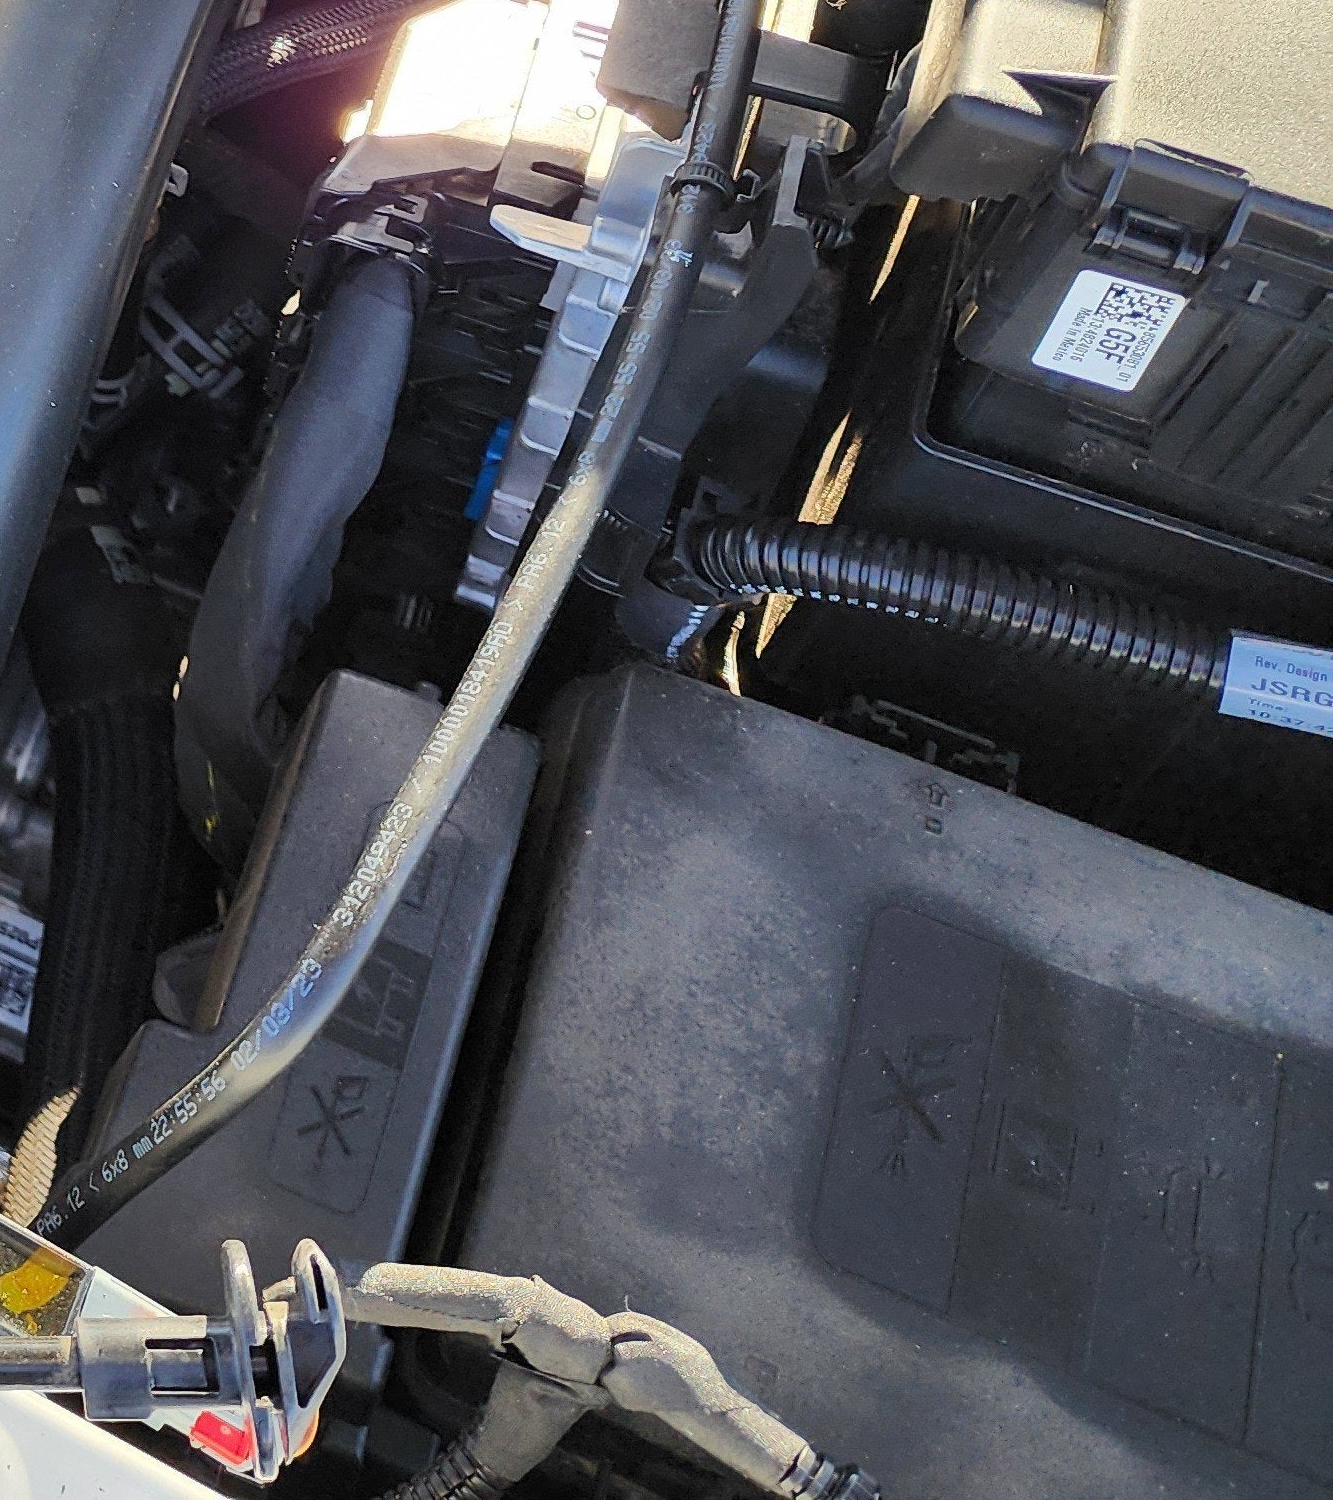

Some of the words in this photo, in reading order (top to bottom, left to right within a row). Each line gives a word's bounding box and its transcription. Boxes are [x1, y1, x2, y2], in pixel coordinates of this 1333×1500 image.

[1052, 337, 1076, 361] Mexico
[1095, 327, 1137, 365] G5F
[1255, 655, 1282, 672] Rev.
[1286, 663, 1328, 682] Design
[101, 1149, 130, 1184] 6x8
[132, 1135, 154, 1160] mm
